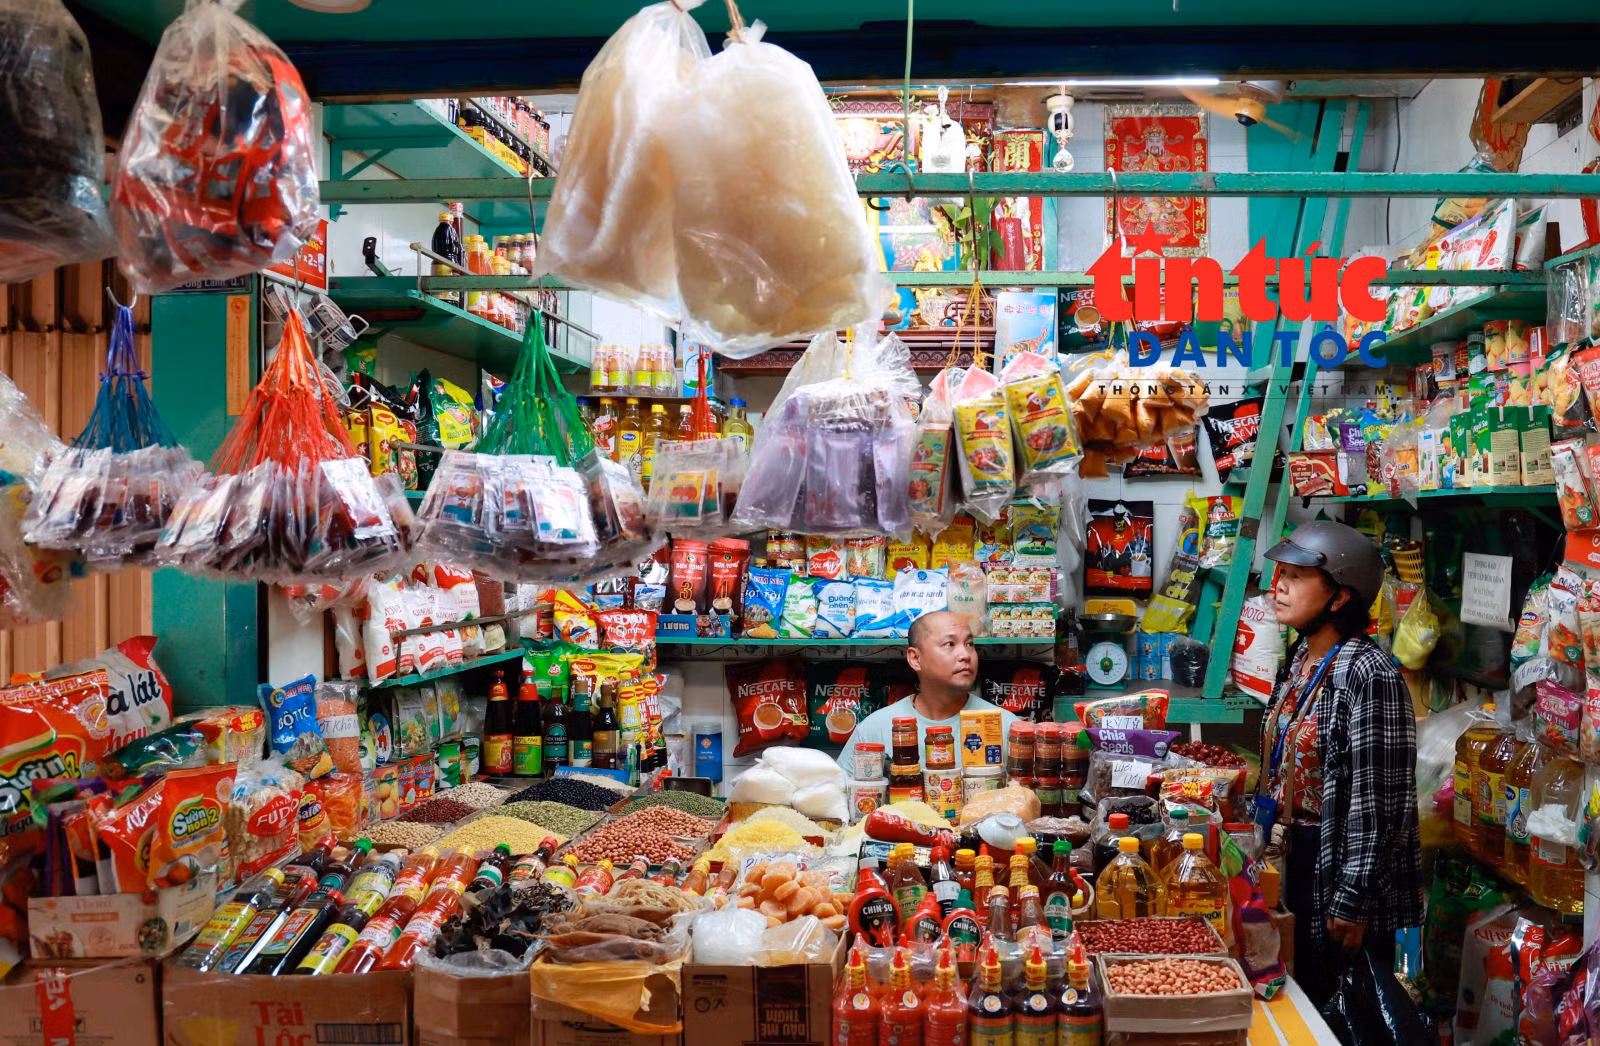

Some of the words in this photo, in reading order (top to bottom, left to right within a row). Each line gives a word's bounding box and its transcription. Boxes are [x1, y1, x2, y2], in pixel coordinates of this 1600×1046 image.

[1240, 605, 1265, 622] MOTO
[1098, 729, 1126, 741] Chia
[1100, 742, 1134, 755] Seeds
[919, 920, 940, 933] CHIN-S
